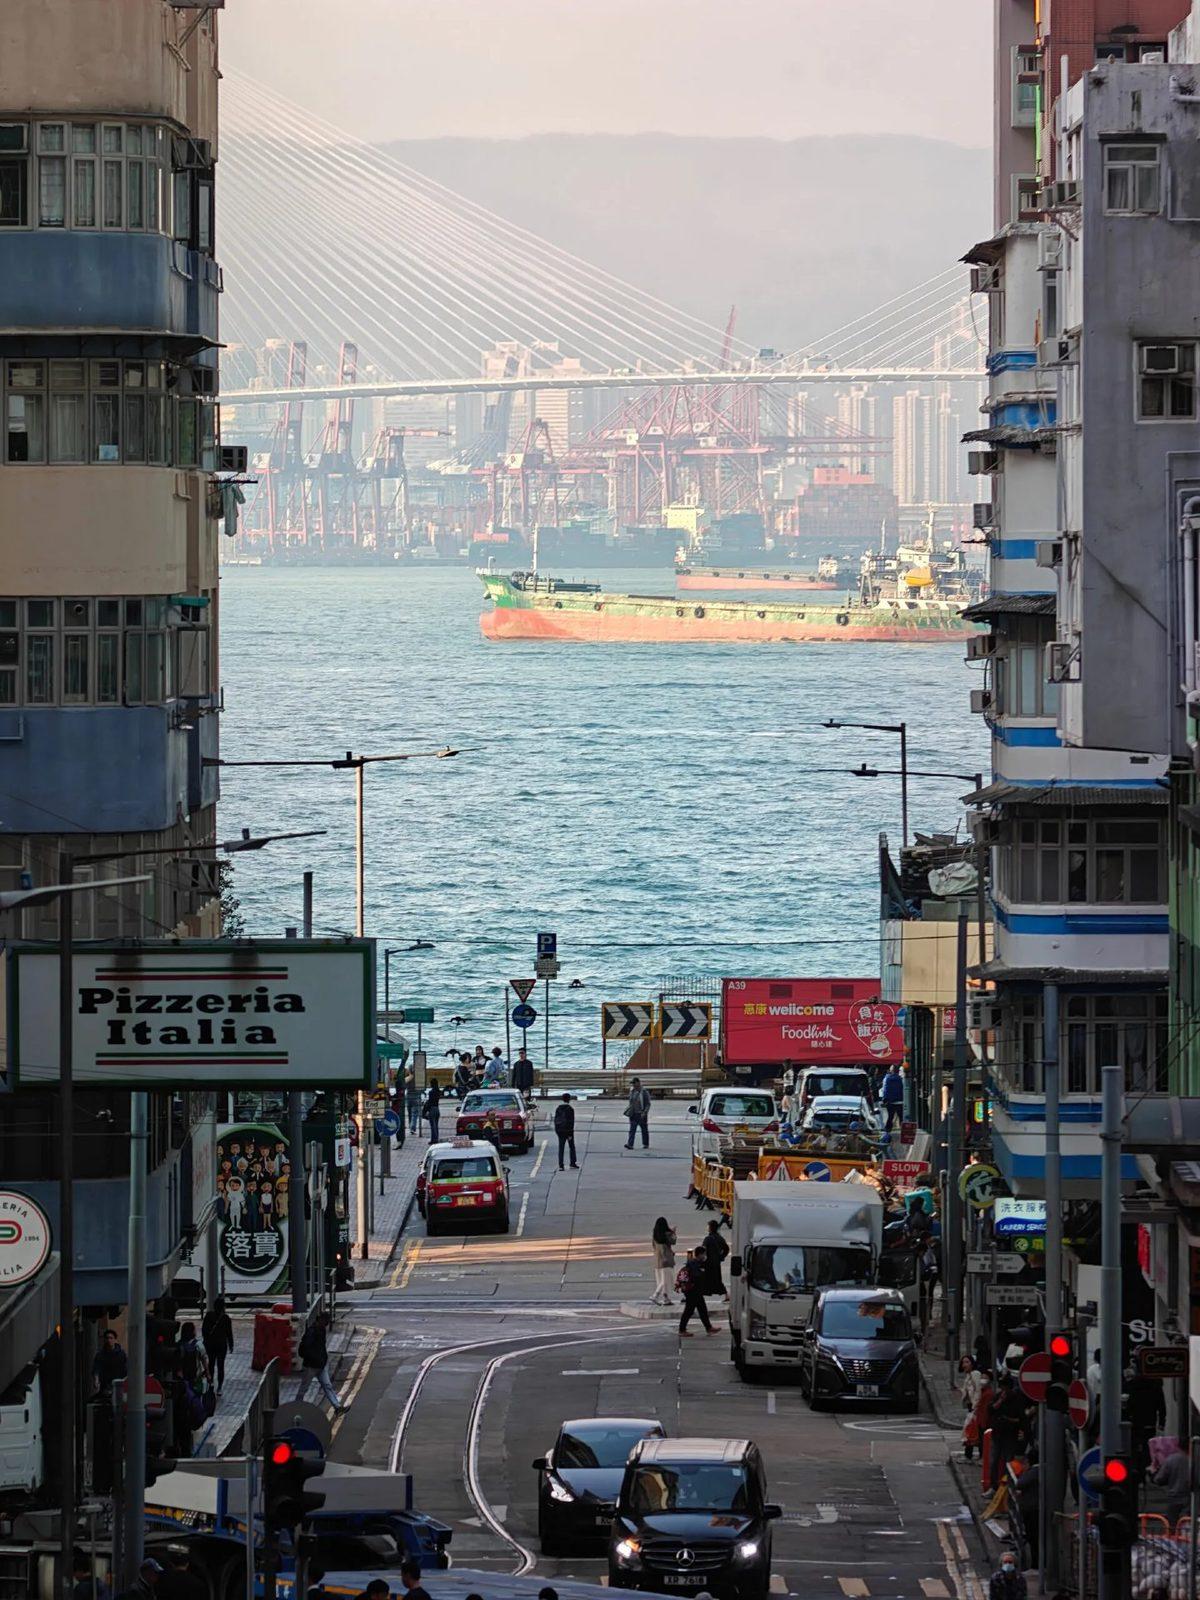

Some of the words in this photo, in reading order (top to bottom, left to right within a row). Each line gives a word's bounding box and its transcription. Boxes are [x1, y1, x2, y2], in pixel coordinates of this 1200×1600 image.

[728, 981, 746, 990] A39
[78, 986, 305, 1014] Pizzeria
[769, 1003, 835, 1016] wellcome
[107, 1018, 277, 1045] Italia
[782, 1024, 842, 1040] Foodlink
[891, 1163, 920, 1172] SLOW
[0, 1201, 28, 1218] ERIA
[1026, 1223, 1047, 1231] SERVIC
[225, 1231, 280, 1257] 落實
